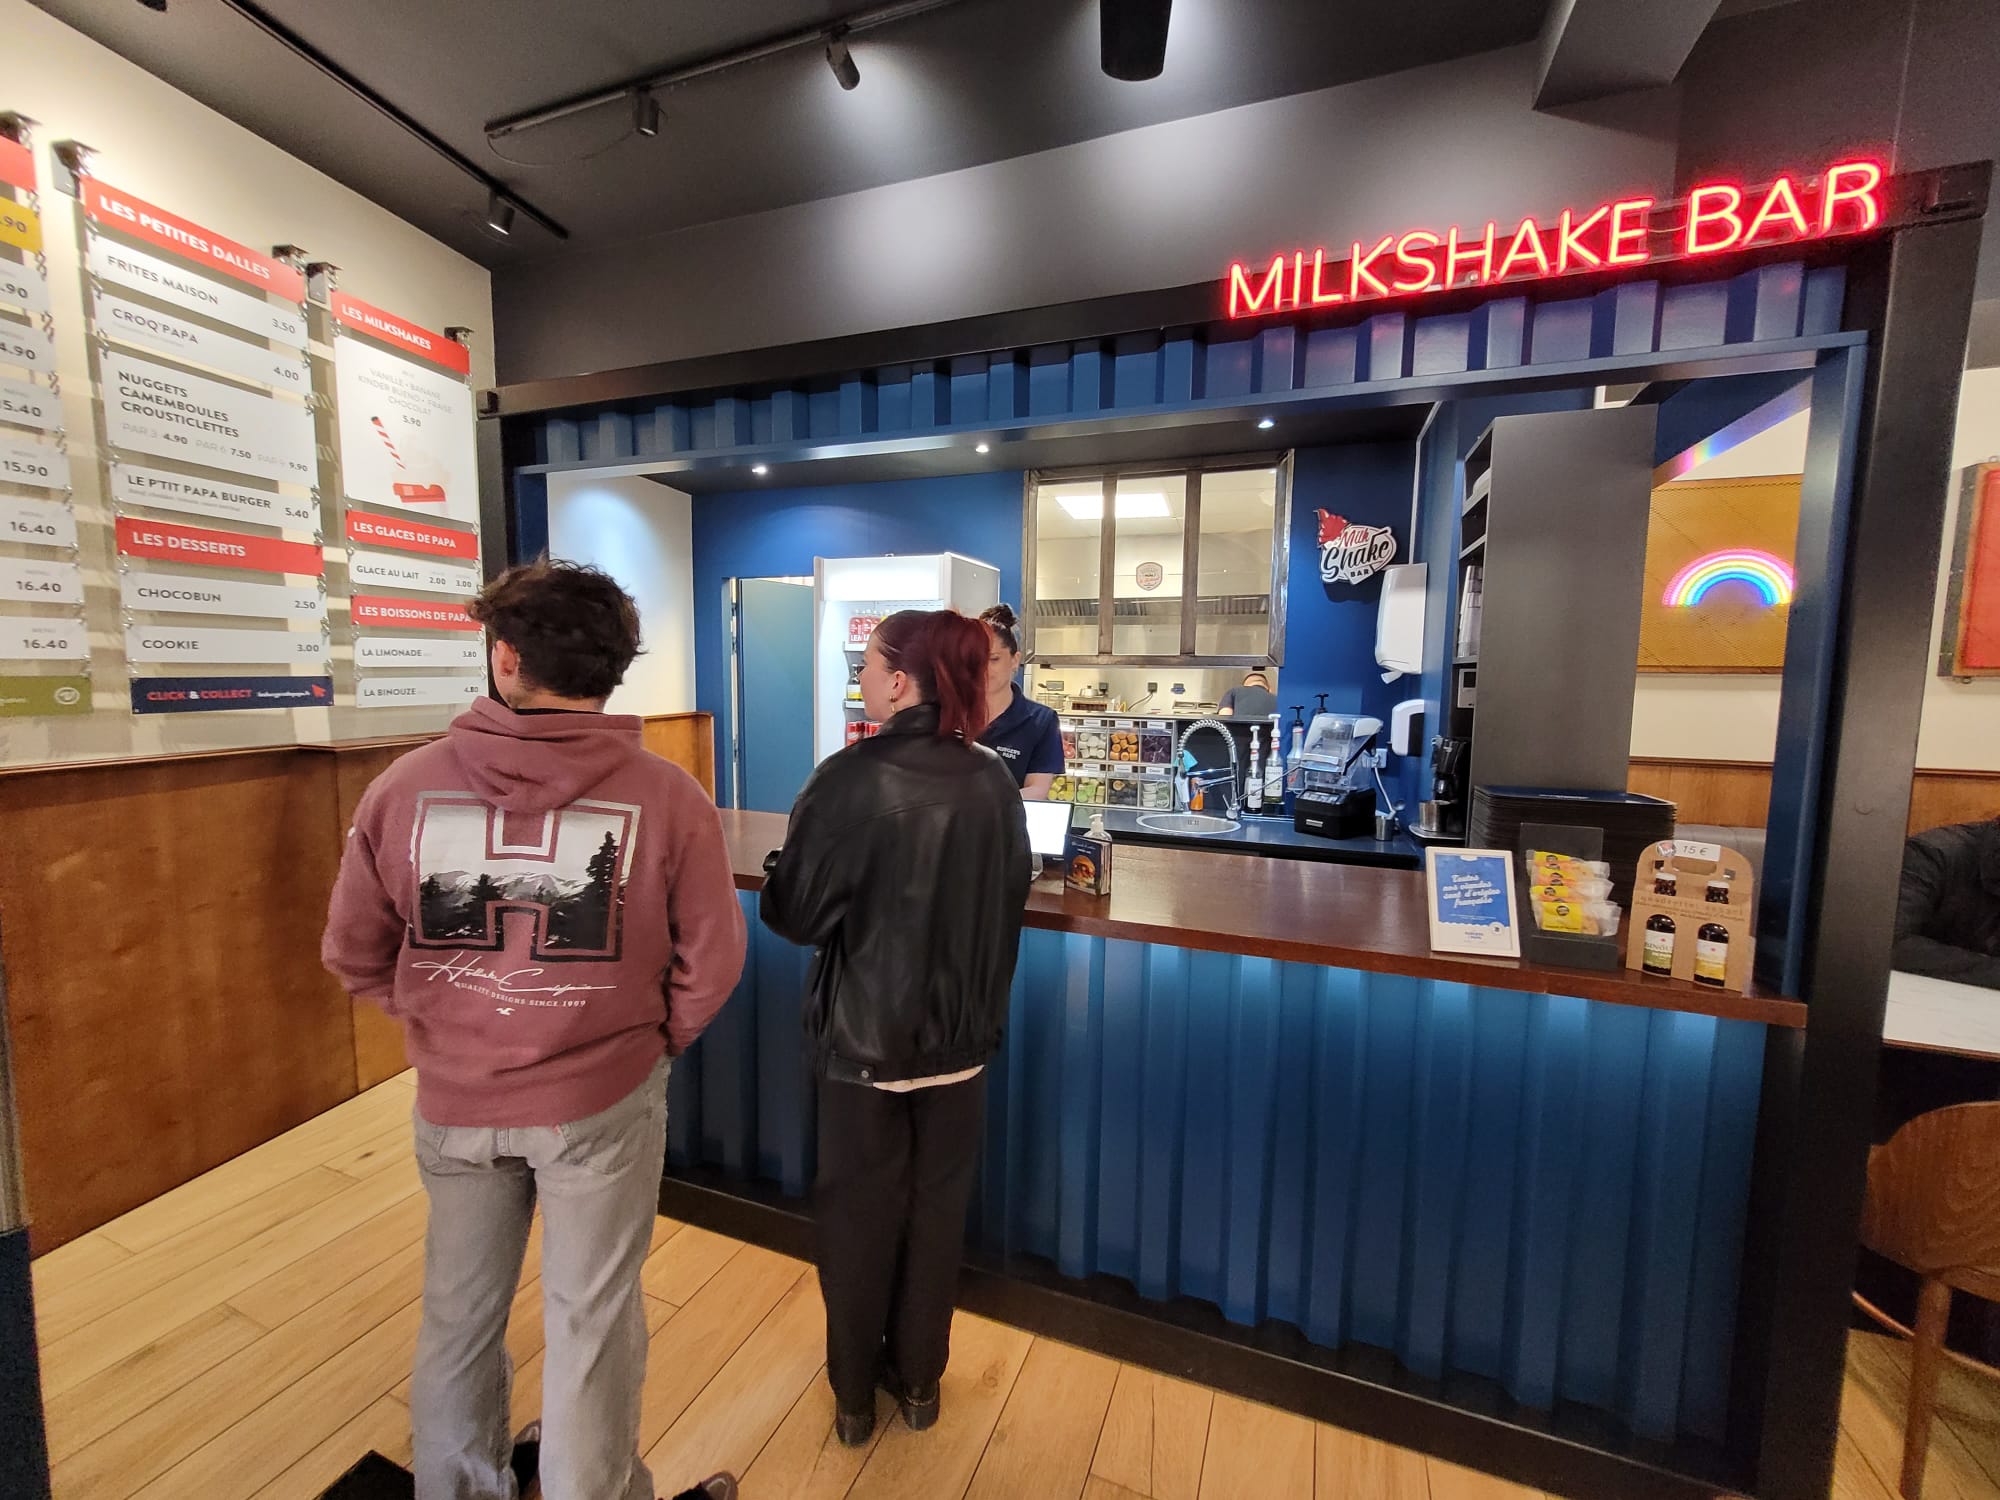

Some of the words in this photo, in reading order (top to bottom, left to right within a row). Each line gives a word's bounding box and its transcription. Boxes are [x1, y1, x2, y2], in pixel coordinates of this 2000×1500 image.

[100, 195, 136, 222] LES
[139, 212, 209, 252] PETITES
[211, 243, 271, 280] DALLES
[1226, 197, 1655, 319] MILKSHAKE
[1684, 160, 1886, 258] BAR
[107, 255, 159, 282] FRITES
[162, 277, 219, 305] MAISON
[272, 317, 296, 334] 3.50
[342, 304, 363, 321] LES
[364, 313, 432, 350] MILKSHAKES
[112, 308, 199, 344] CROQ'PAPA
[273, 365, 300, 381] 4.00
[118, 371, 188, 398] NUGGETS
[119, 386, 229, 422] CAMEMBOULES
[121, 401, 240, 438] CROUSTICLETTES
[402, 414, 421, 427] 5.90
[163, 433, 188, 445] 4.90
[231, 448, 252, 459] 7.50
[288, 462, 309, 472] 9.90
[3, 460, 48, 477] 15.90
[128, 475, 145, 486] LE
[148, 478, 181, 493] P'TIT
[183, 485, 219, 500] PAPA
[221, 492, 271, 509] BURGER
[285, 507, 309, 519] 5.40
[10, 521, 56, 536] 16.40
[353, 521, 375, 534] LES
[376, 525, 415, 542] GLACES
[416, 533, 430, 544] DE
[432, 536, 456, 549] PAPA
[1339, 528, 1369, 548] Milk
[133, 531, 163, 547] LES
[167, 536, 247, 557] DESSERTS
[1324, 530, 1390, 579] Shake
[356, 565, 386, 577] GLACE
[387, 569, 401, 578] AU
[402, 571, 420, 580] LAIT
[429, 576, 446, 585] 2.00
[456, 579, 473, 588] 3.00
[1350, 568, 1370, 578] BAR
[16, 581, 62, 593] 16.40
[137, 587, 222, 602] CHOCOBUN
[294, 600, 317, 610] 2.50
[359, 606, 379, 617] LES
[380, 607, 432, 621] BOISSONS
[433, 612, 448, 622] DE
[23, 639, 68, 650] 16.40
[142, 639, 200, 650] COOKIE
[297, 644, 320, 653] 3.00
[362, 649, 374, 657] LA
[375, 649, 422, 657] LIMONADE
[147, 690, 186, 701] CLICK
[189, 690, 200, 699] &
[201, 689, 252, 699] COLLECT
[364, 689, 375, 697] LA
[1682, 845, 1696, 855] 15
[1699, 847, 1710, 856] €
[454, 981, 490, 996] QUALITY
[491, 991, 526, 1006] DESIGNS
[529, 999, 558, 1007] SINCE
